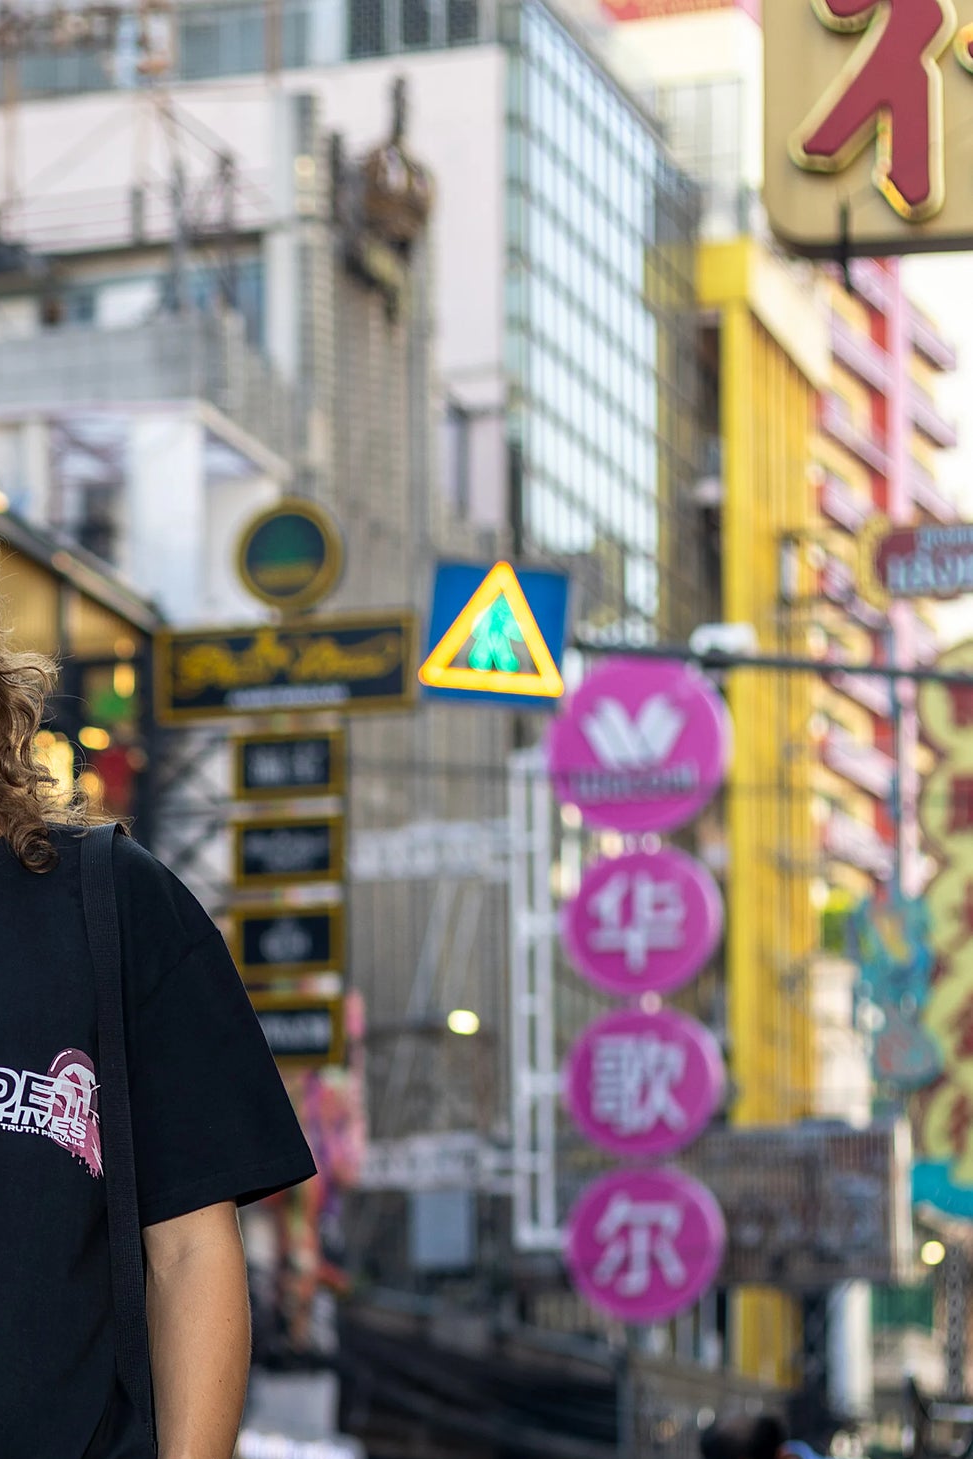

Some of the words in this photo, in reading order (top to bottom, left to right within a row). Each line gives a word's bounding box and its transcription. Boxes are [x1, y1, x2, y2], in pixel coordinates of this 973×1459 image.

[0, 1122, 40, 1135] TRUTH
[41, 1129, 86, 1149] PREVAILS
[587, 869, 688, 1297] 华歌尔
